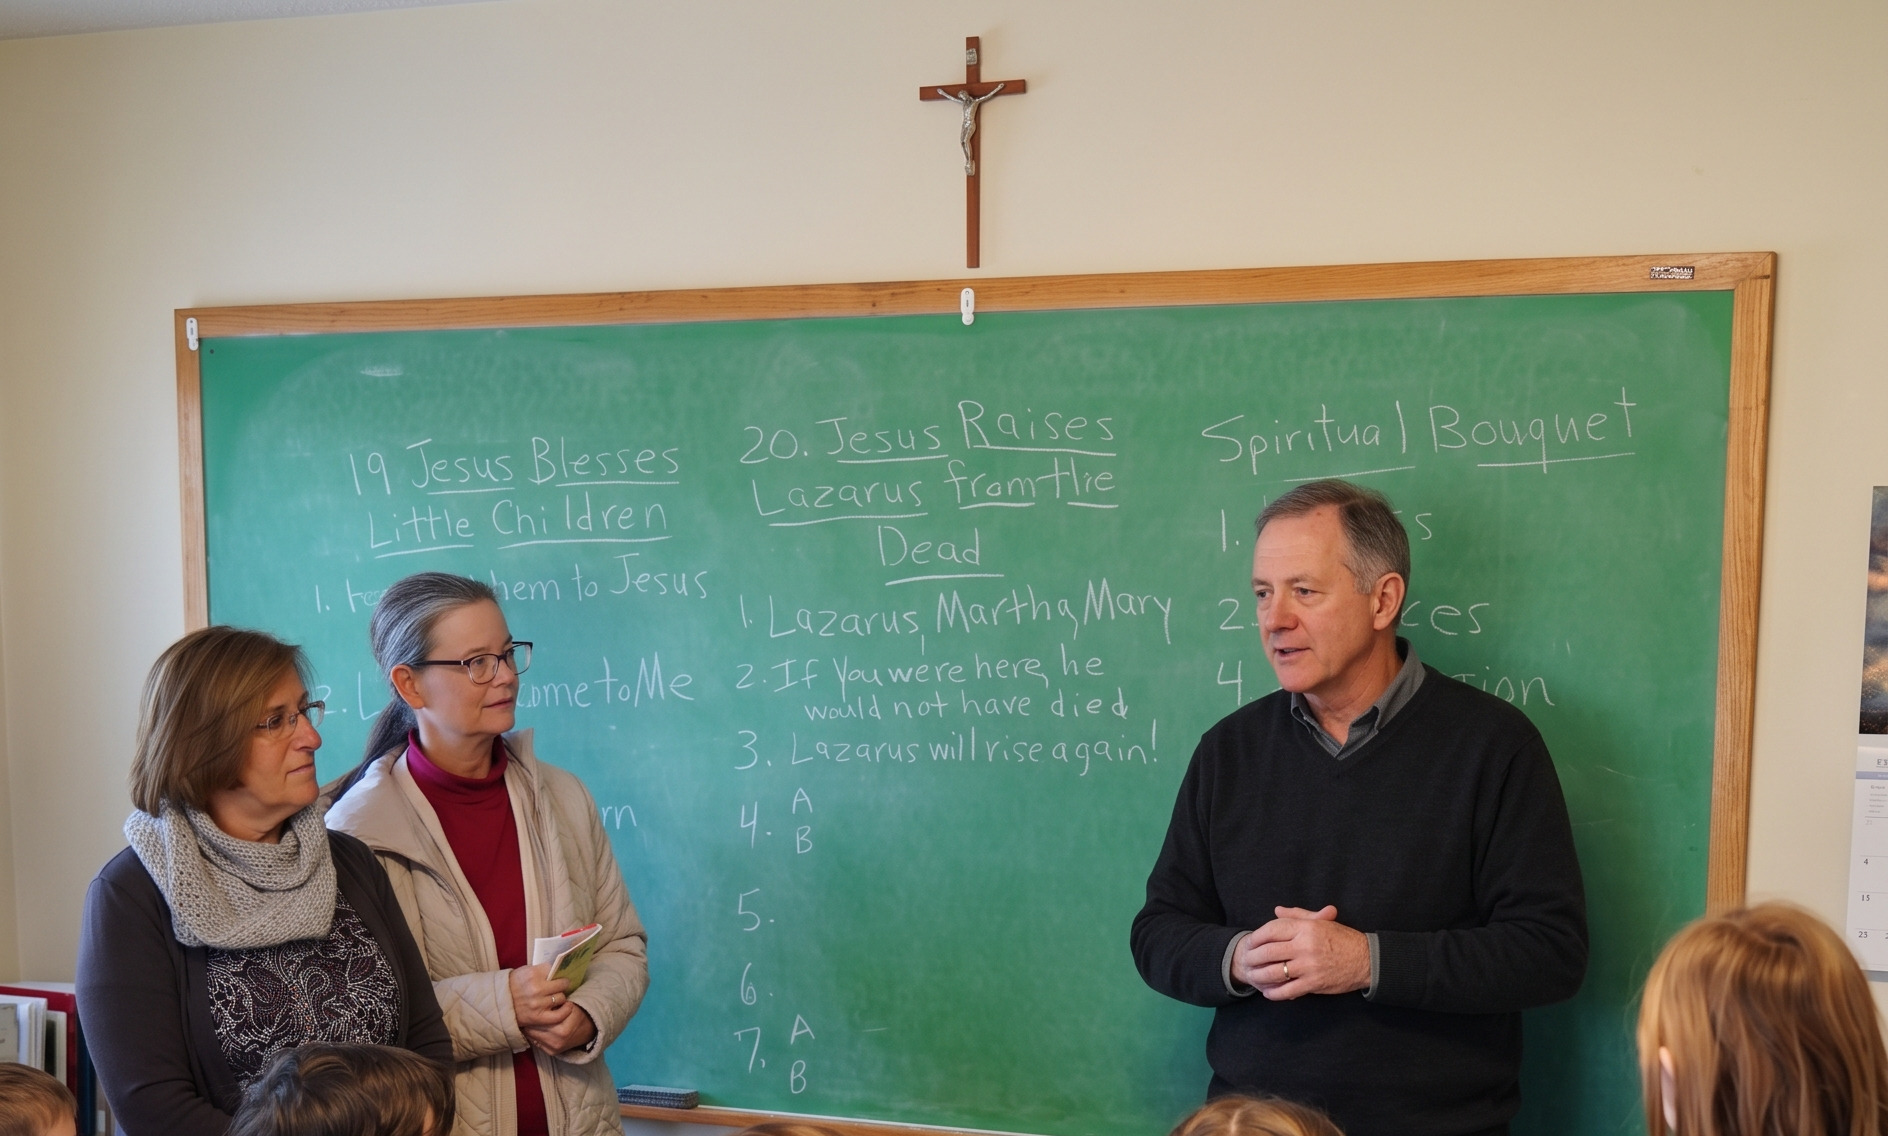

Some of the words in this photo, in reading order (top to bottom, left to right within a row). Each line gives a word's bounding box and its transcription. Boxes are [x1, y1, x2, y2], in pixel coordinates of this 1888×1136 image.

[740, 426, 809, 465] 20.
[815, 416, 941, 456] Jesus
[957, 400, 1115, 450] Raises
[1200, 399, 1407, 476] Spiritual
[1429, 385, 1637, 475] Bouquet
[349, 451, 391, 496] 19
[406, 437, 514, 489] Jesus
[527, 435, 680, 486] Blesses
[752, 478, 924, 517] Lazarus
[943, 459, 1036, 504] from
[368, 504, 475, 549] Little
[491, 490, 667, 536] Children
[1220, 508, 1240, 552] 1.
[877, 524, 981, 567] Dead
[315, 584, 331, 614] 1.
[469, 568, 560, 601] hem
[570, 562, 598, 601] to
[609, 552, 708, 599] Jesus
[739, 593, 754, 629] 1.
[1083, 577, 1172, 645] Mary
[593, 656, 631, 704] to
[634, 651, 696, 708] Me
[735, 662, 768, 690] 2.
[770, 657, 820, 693] If
[887, 664, 967, 684] were
[1060, 642, 1105, 677] he
[803, 693, 883, 722] would
[894, 690, 950, 719] not
[961, 688, 1032, 717] have
[1049, 686, 1130, 720] died
[733, 729, 772, 771] 3.
[790, 731, 921, 766] Lazarus
[929, 725, 976, 762] will
[986, 734, 1043, 763] rise
[740, 800, 772, 850] 4.
[792, 787, 813, 815] A
[796, 825, 813, 854] B
[738, 887, 775, 931] 5.
[740, 961, 774, 1006] 6.
[790, 1013, 816, 1045] A
[790, 1059, 807, 1094] B
